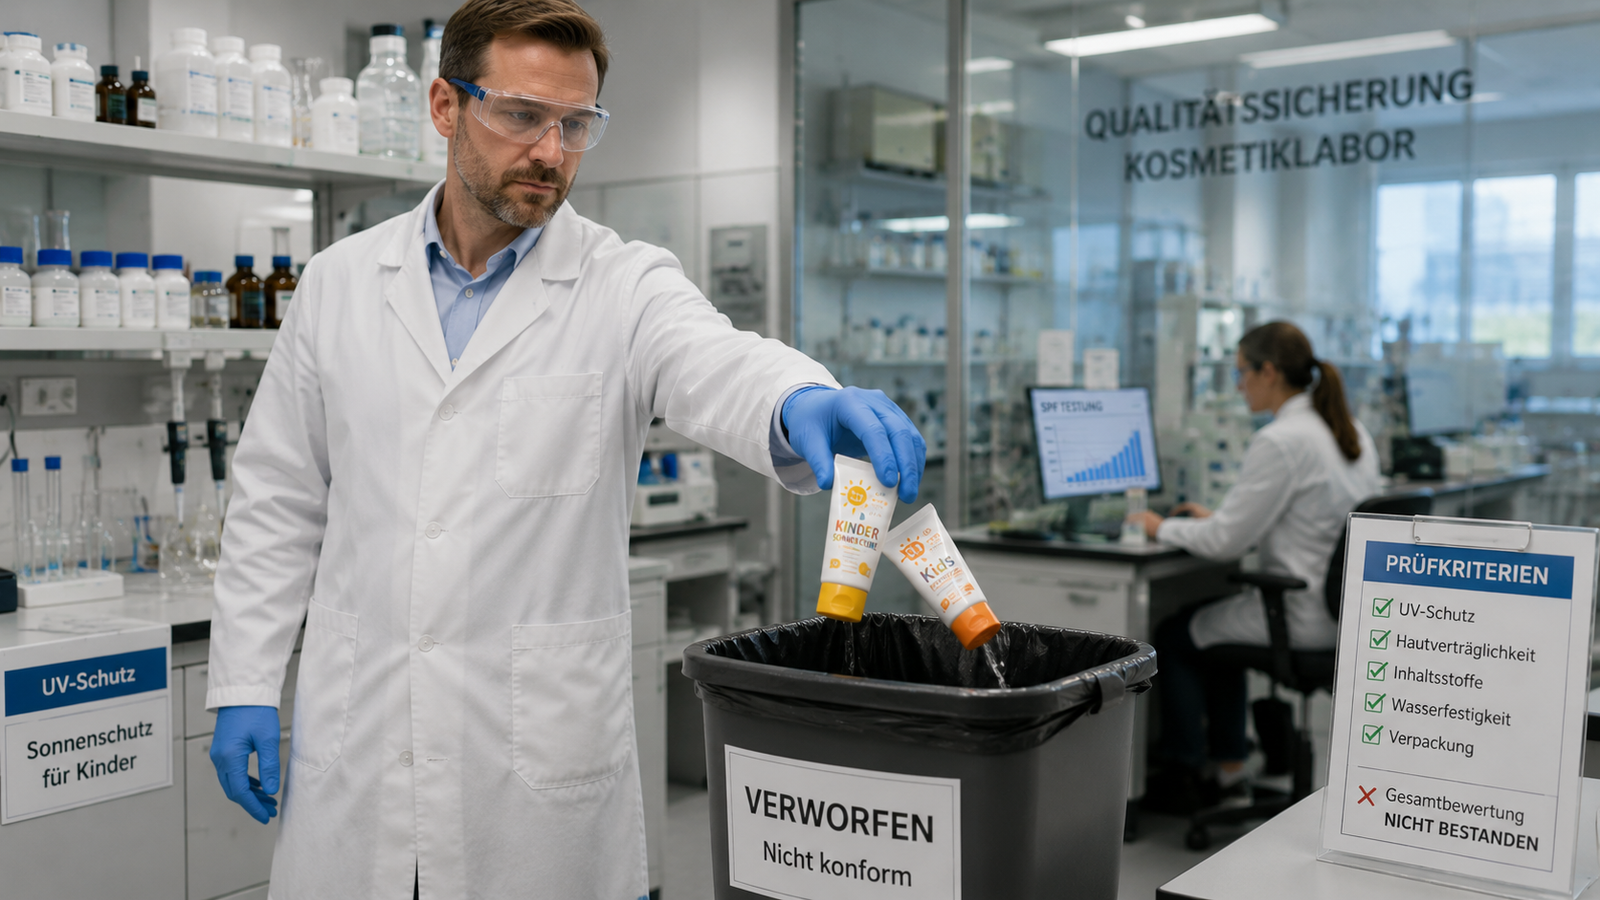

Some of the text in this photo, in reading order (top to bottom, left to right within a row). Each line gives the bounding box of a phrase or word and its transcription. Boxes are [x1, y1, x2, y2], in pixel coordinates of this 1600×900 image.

[1085, 69, 1474, 141] QUALITÄTSSICHERUNG
[1124, 128, 1416, 182] KOSMETIKLABOR
[1040, 401, 1103, 413] SPF TESTUNG
[835, 519, 879, 540] KINDER
[920, 556, 955, 583] Kids
[1386, 553, 1549, 585] PRÜFKRITERIEN
[1399, 602, 1476, 623] UV-Schutz
[1396, 634, 1536, 662] Hautverträglichkeit
[42, 667, 136, 696] UV-Schutz
[1393, 665, 1483, 689] Inhaltsstoffe
[1392, 697, 1511, 726] Wasserfestigkeit
[27, 721, 153, 759] Sonnenschutz
[1389, 730, 1475, 757] Verpackung
[42, 754, 137, 788] für Kinder
[745, 785, 934, 843] VERWORFEN
[1385, 787, 1525, 826] Gesamtbewertung
[1384, 812, 1539, 852] NICHT BESTANDEN
[763, 841, 912, 887] Nicht konform
